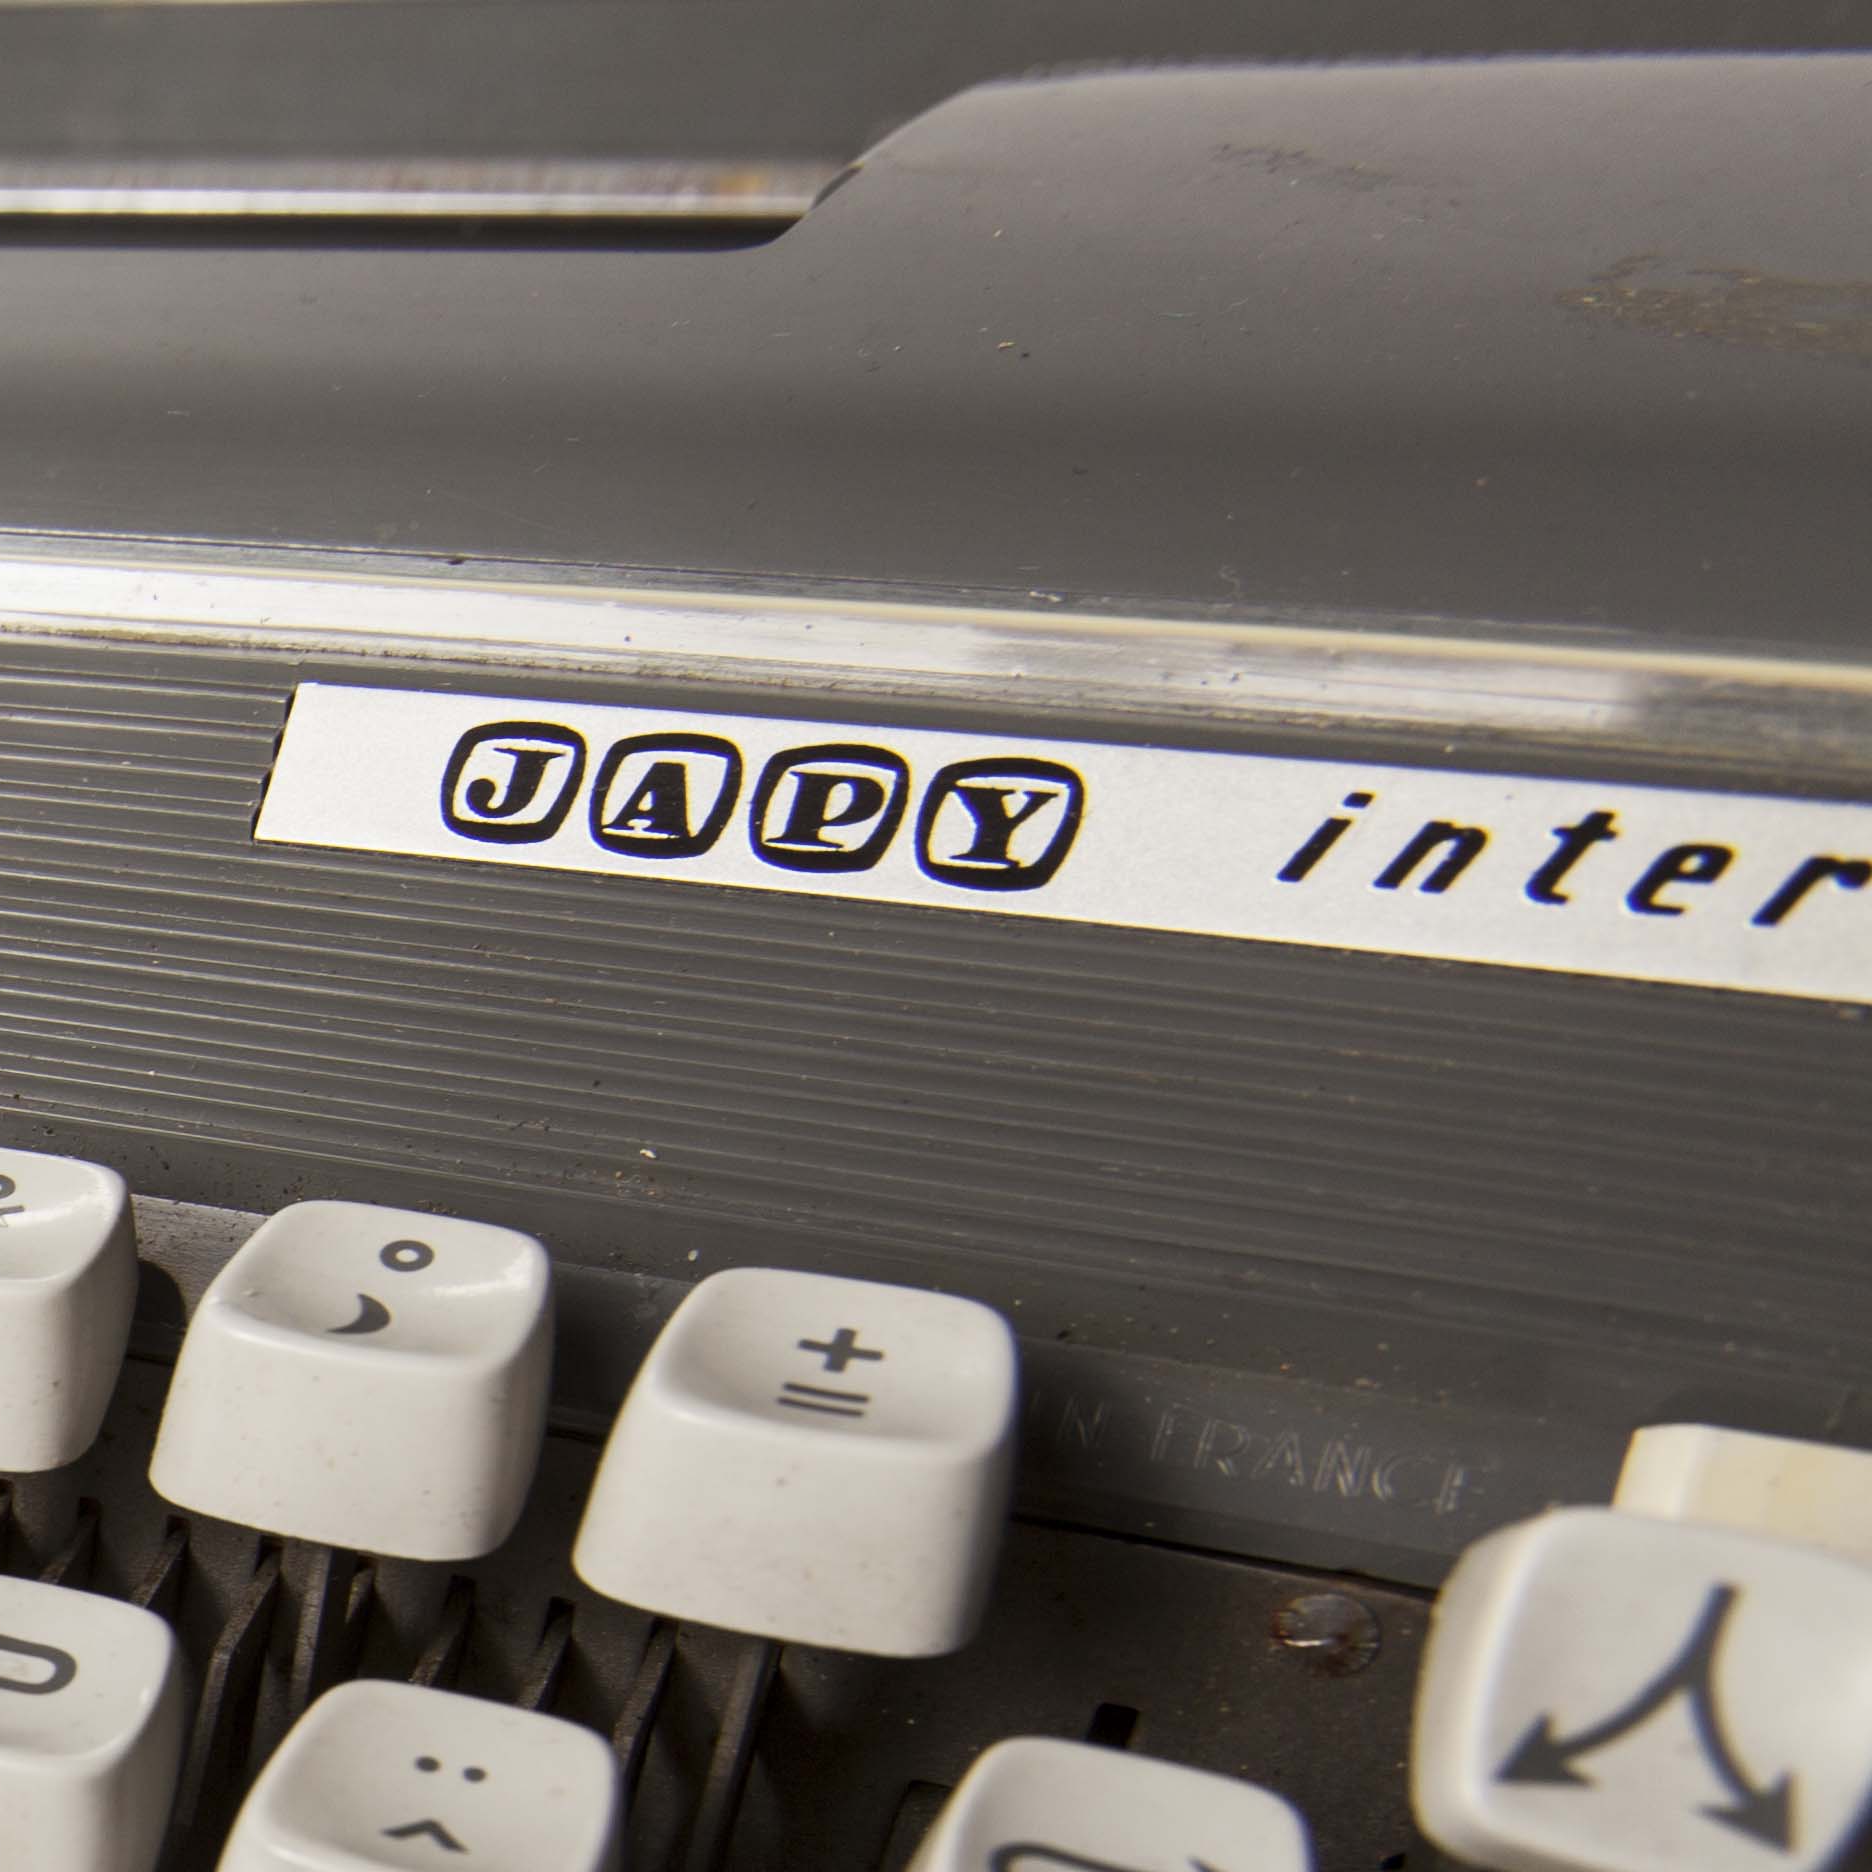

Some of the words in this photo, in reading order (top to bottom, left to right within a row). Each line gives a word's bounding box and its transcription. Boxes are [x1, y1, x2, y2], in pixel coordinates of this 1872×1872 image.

[462, 744, 1062, 872] JAPY
[1275, 791, 1872, 927] inter
[798, 1328, 883, 1373] +
[775, 1382, 869, 1418] =
[1149, 1402, 1494, 1515] FRANCE
